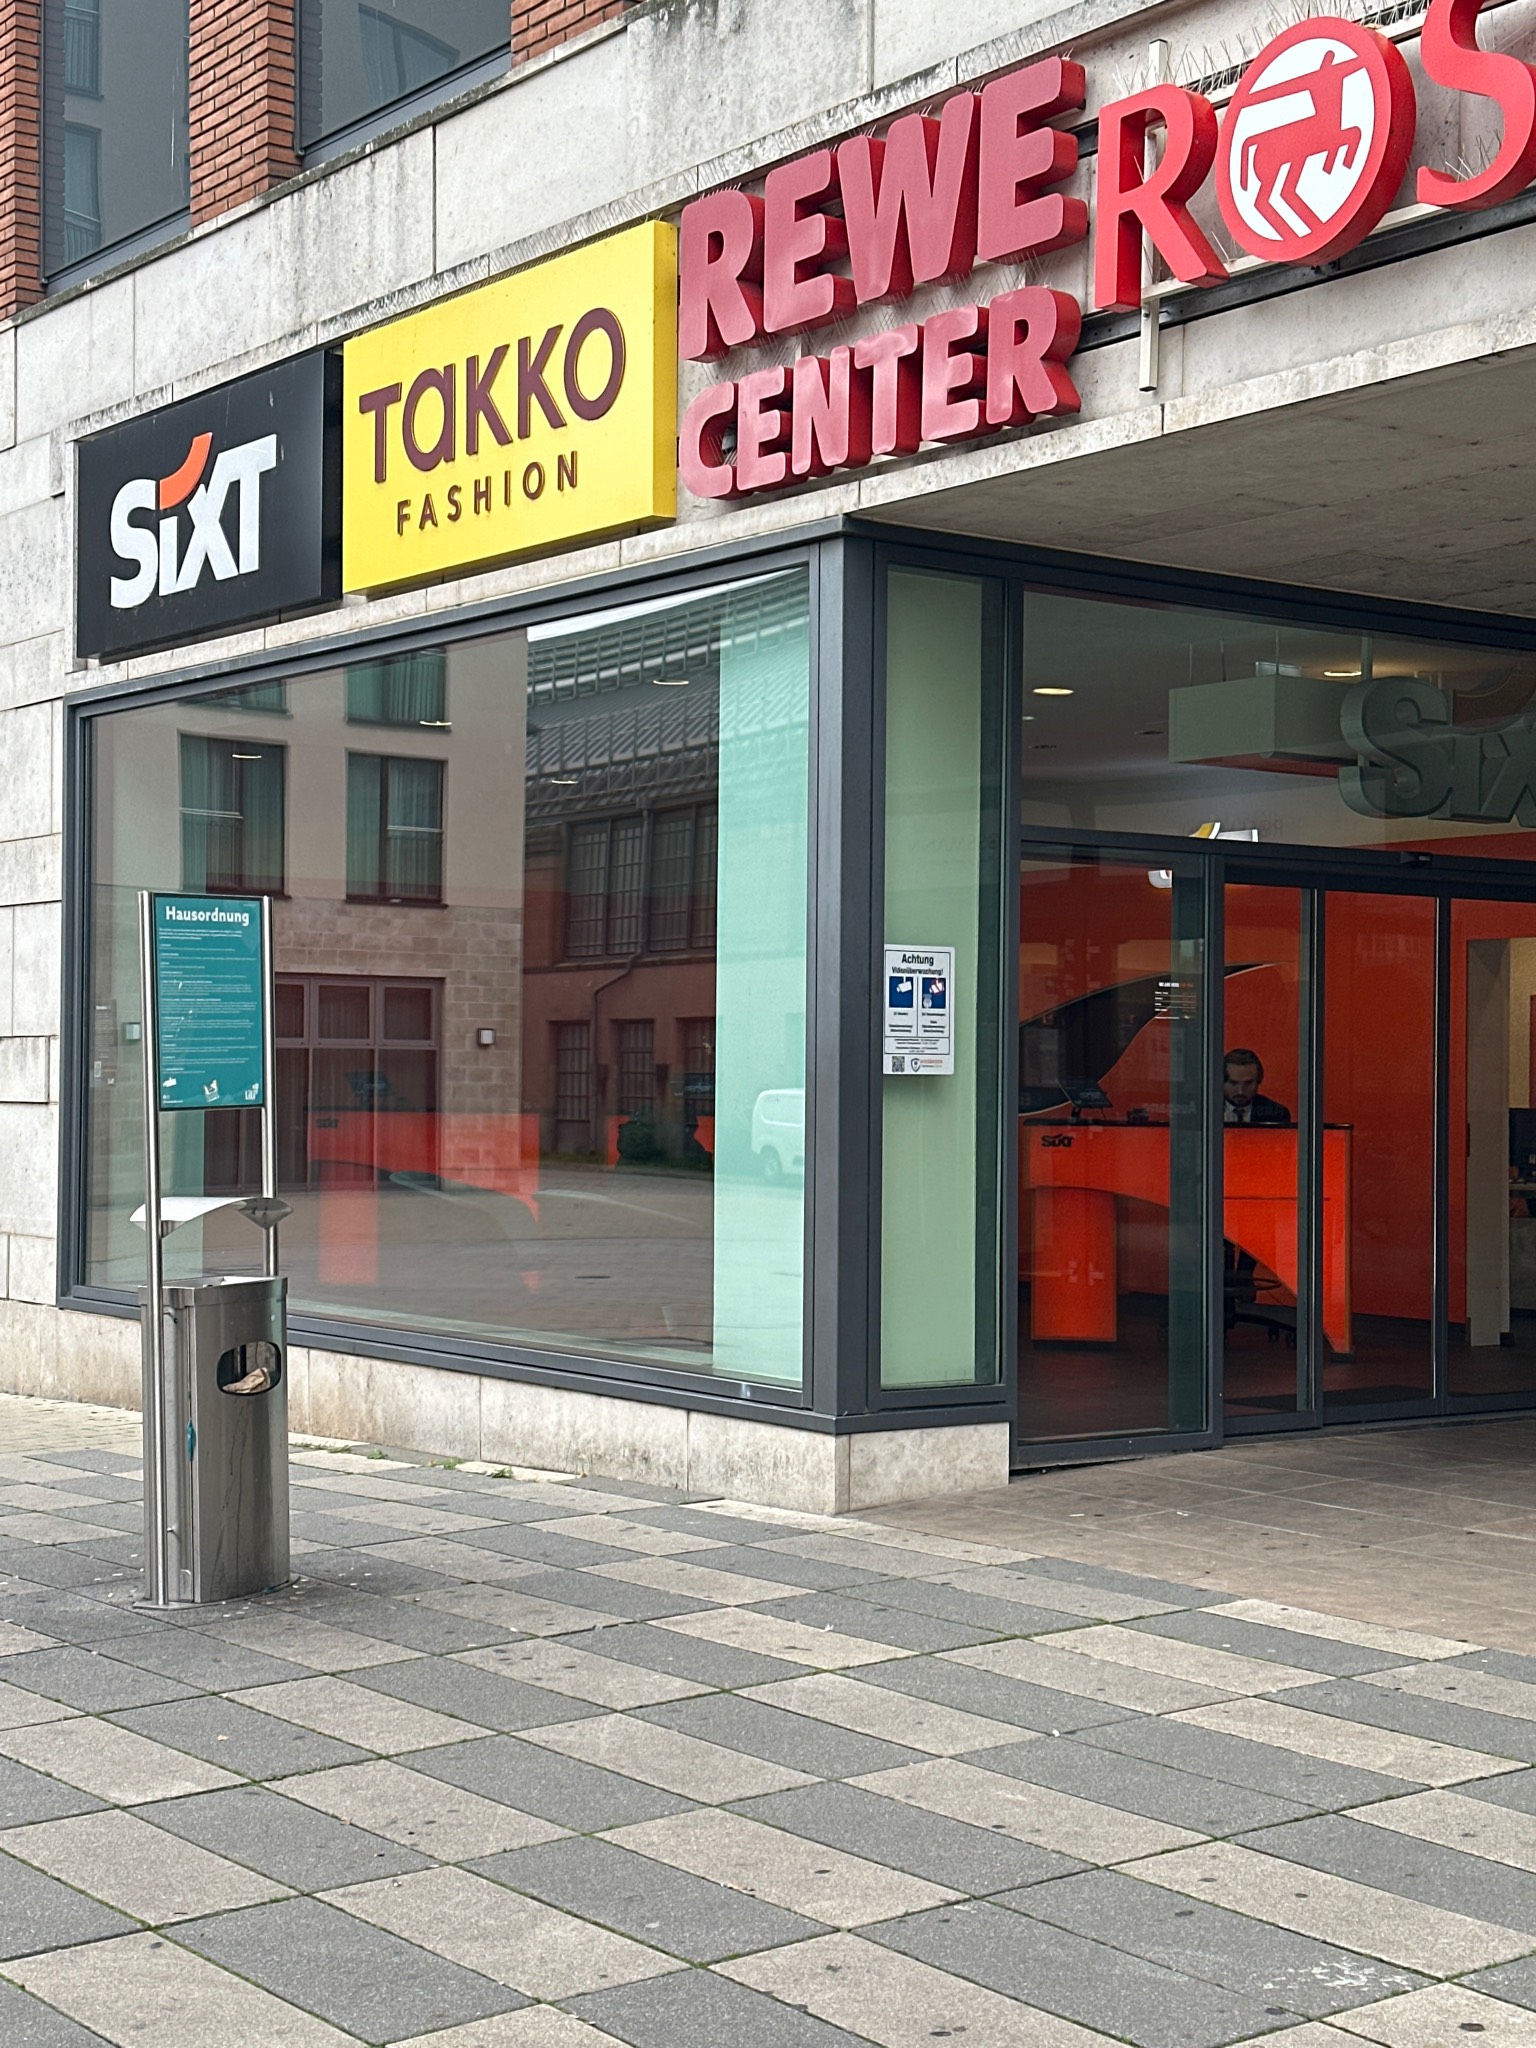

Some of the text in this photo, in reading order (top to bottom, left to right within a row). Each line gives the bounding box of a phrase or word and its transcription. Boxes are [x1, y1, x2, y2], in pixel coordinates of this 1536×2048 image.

[679, 55, 1090, 363] REWE
[679, 285, 1083, 500] CENTER
[397, 450, 578, 536] FASHION
[165, 905, 250, 927] Hausordnung
[901, 953, 934, 967] Achtung
